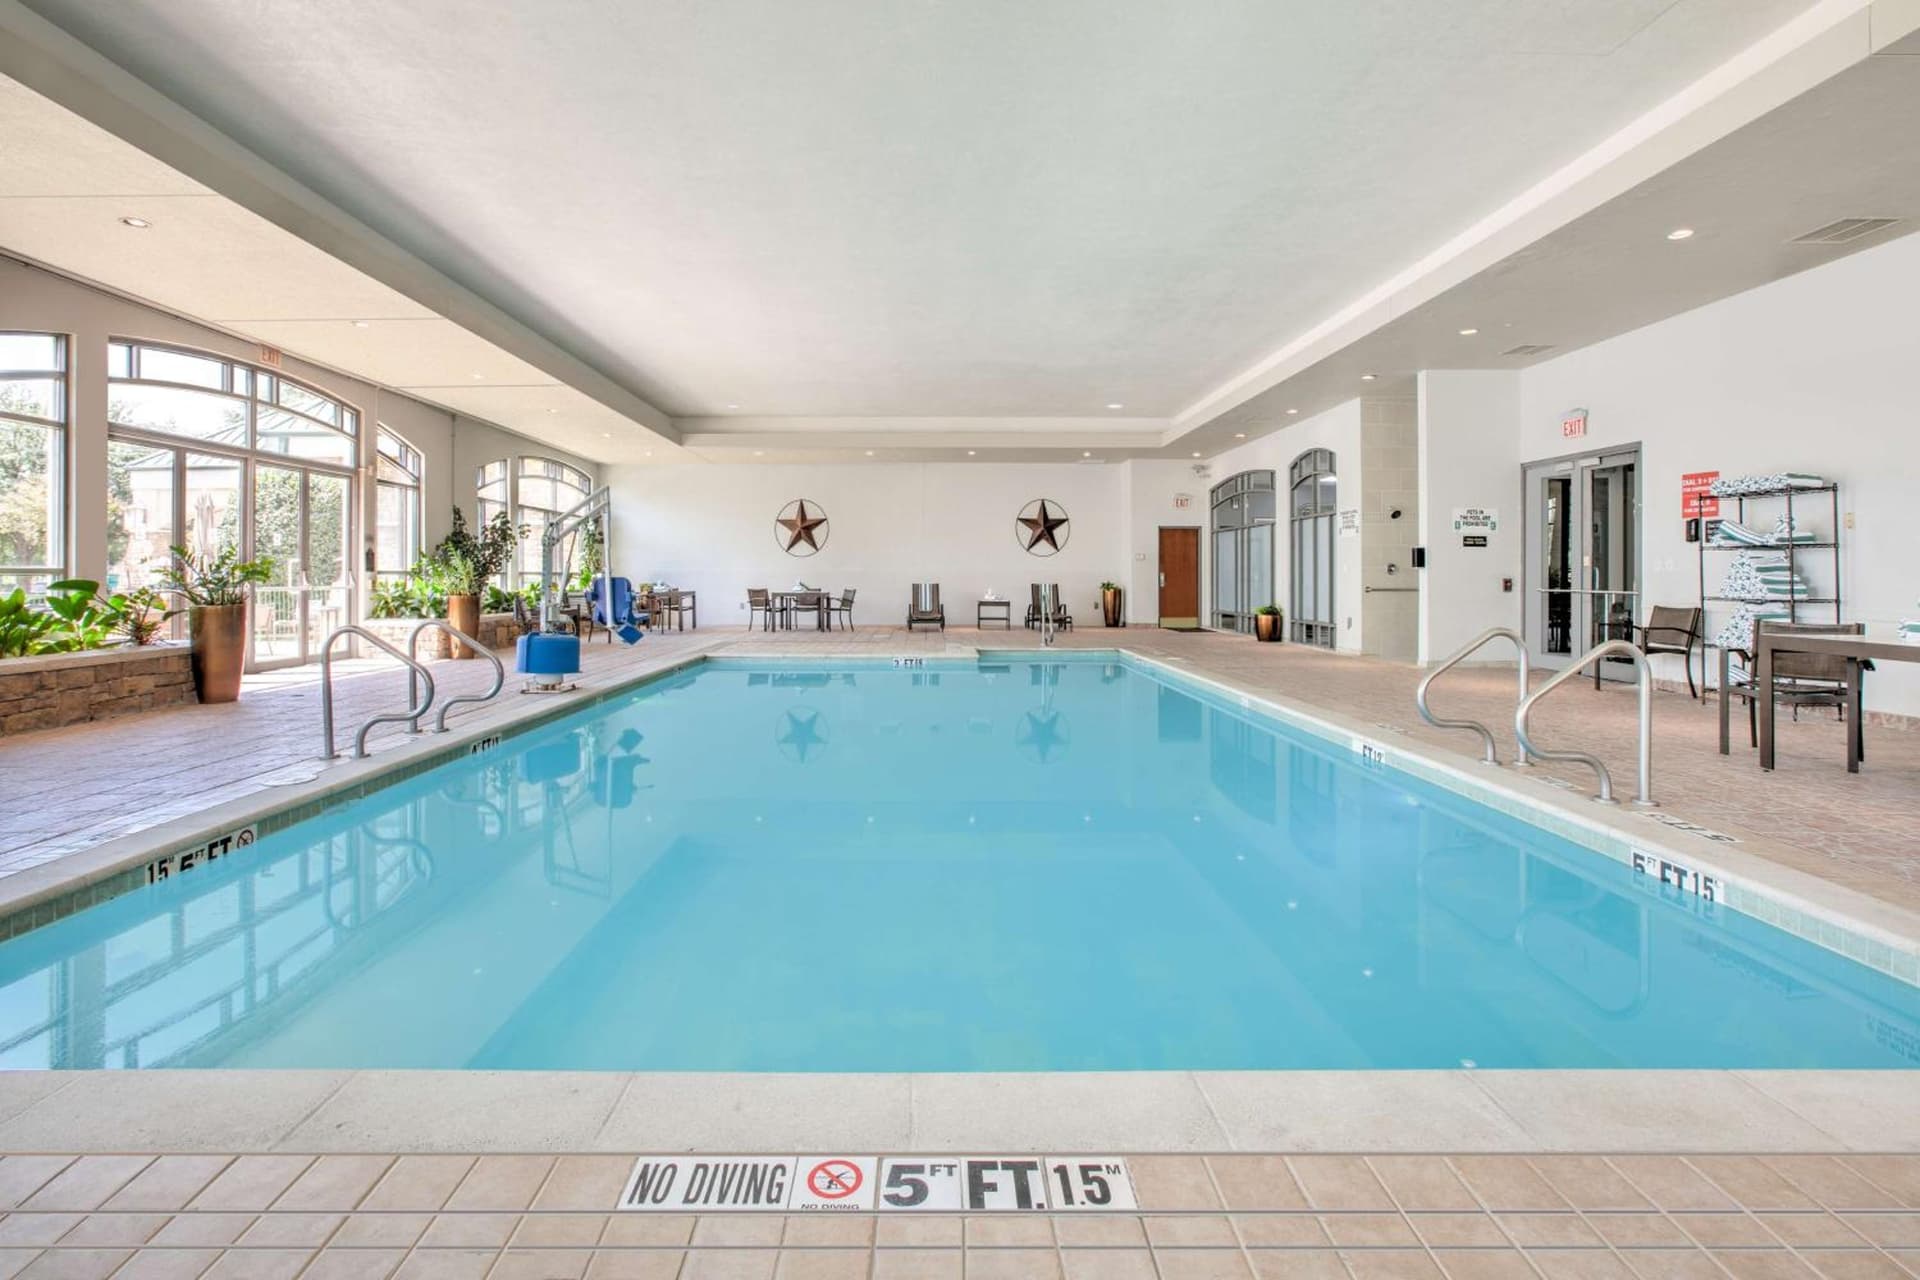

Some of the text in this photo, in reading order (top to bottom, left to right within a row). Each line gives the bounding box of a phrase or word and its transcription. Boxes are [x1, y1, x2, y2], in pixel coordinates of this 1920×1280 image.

[1563, 419, 1581, 437] EXIT
[1660, 860, 1688, 889] FT
[627, 1162, 787, 1205] NO DIVING
